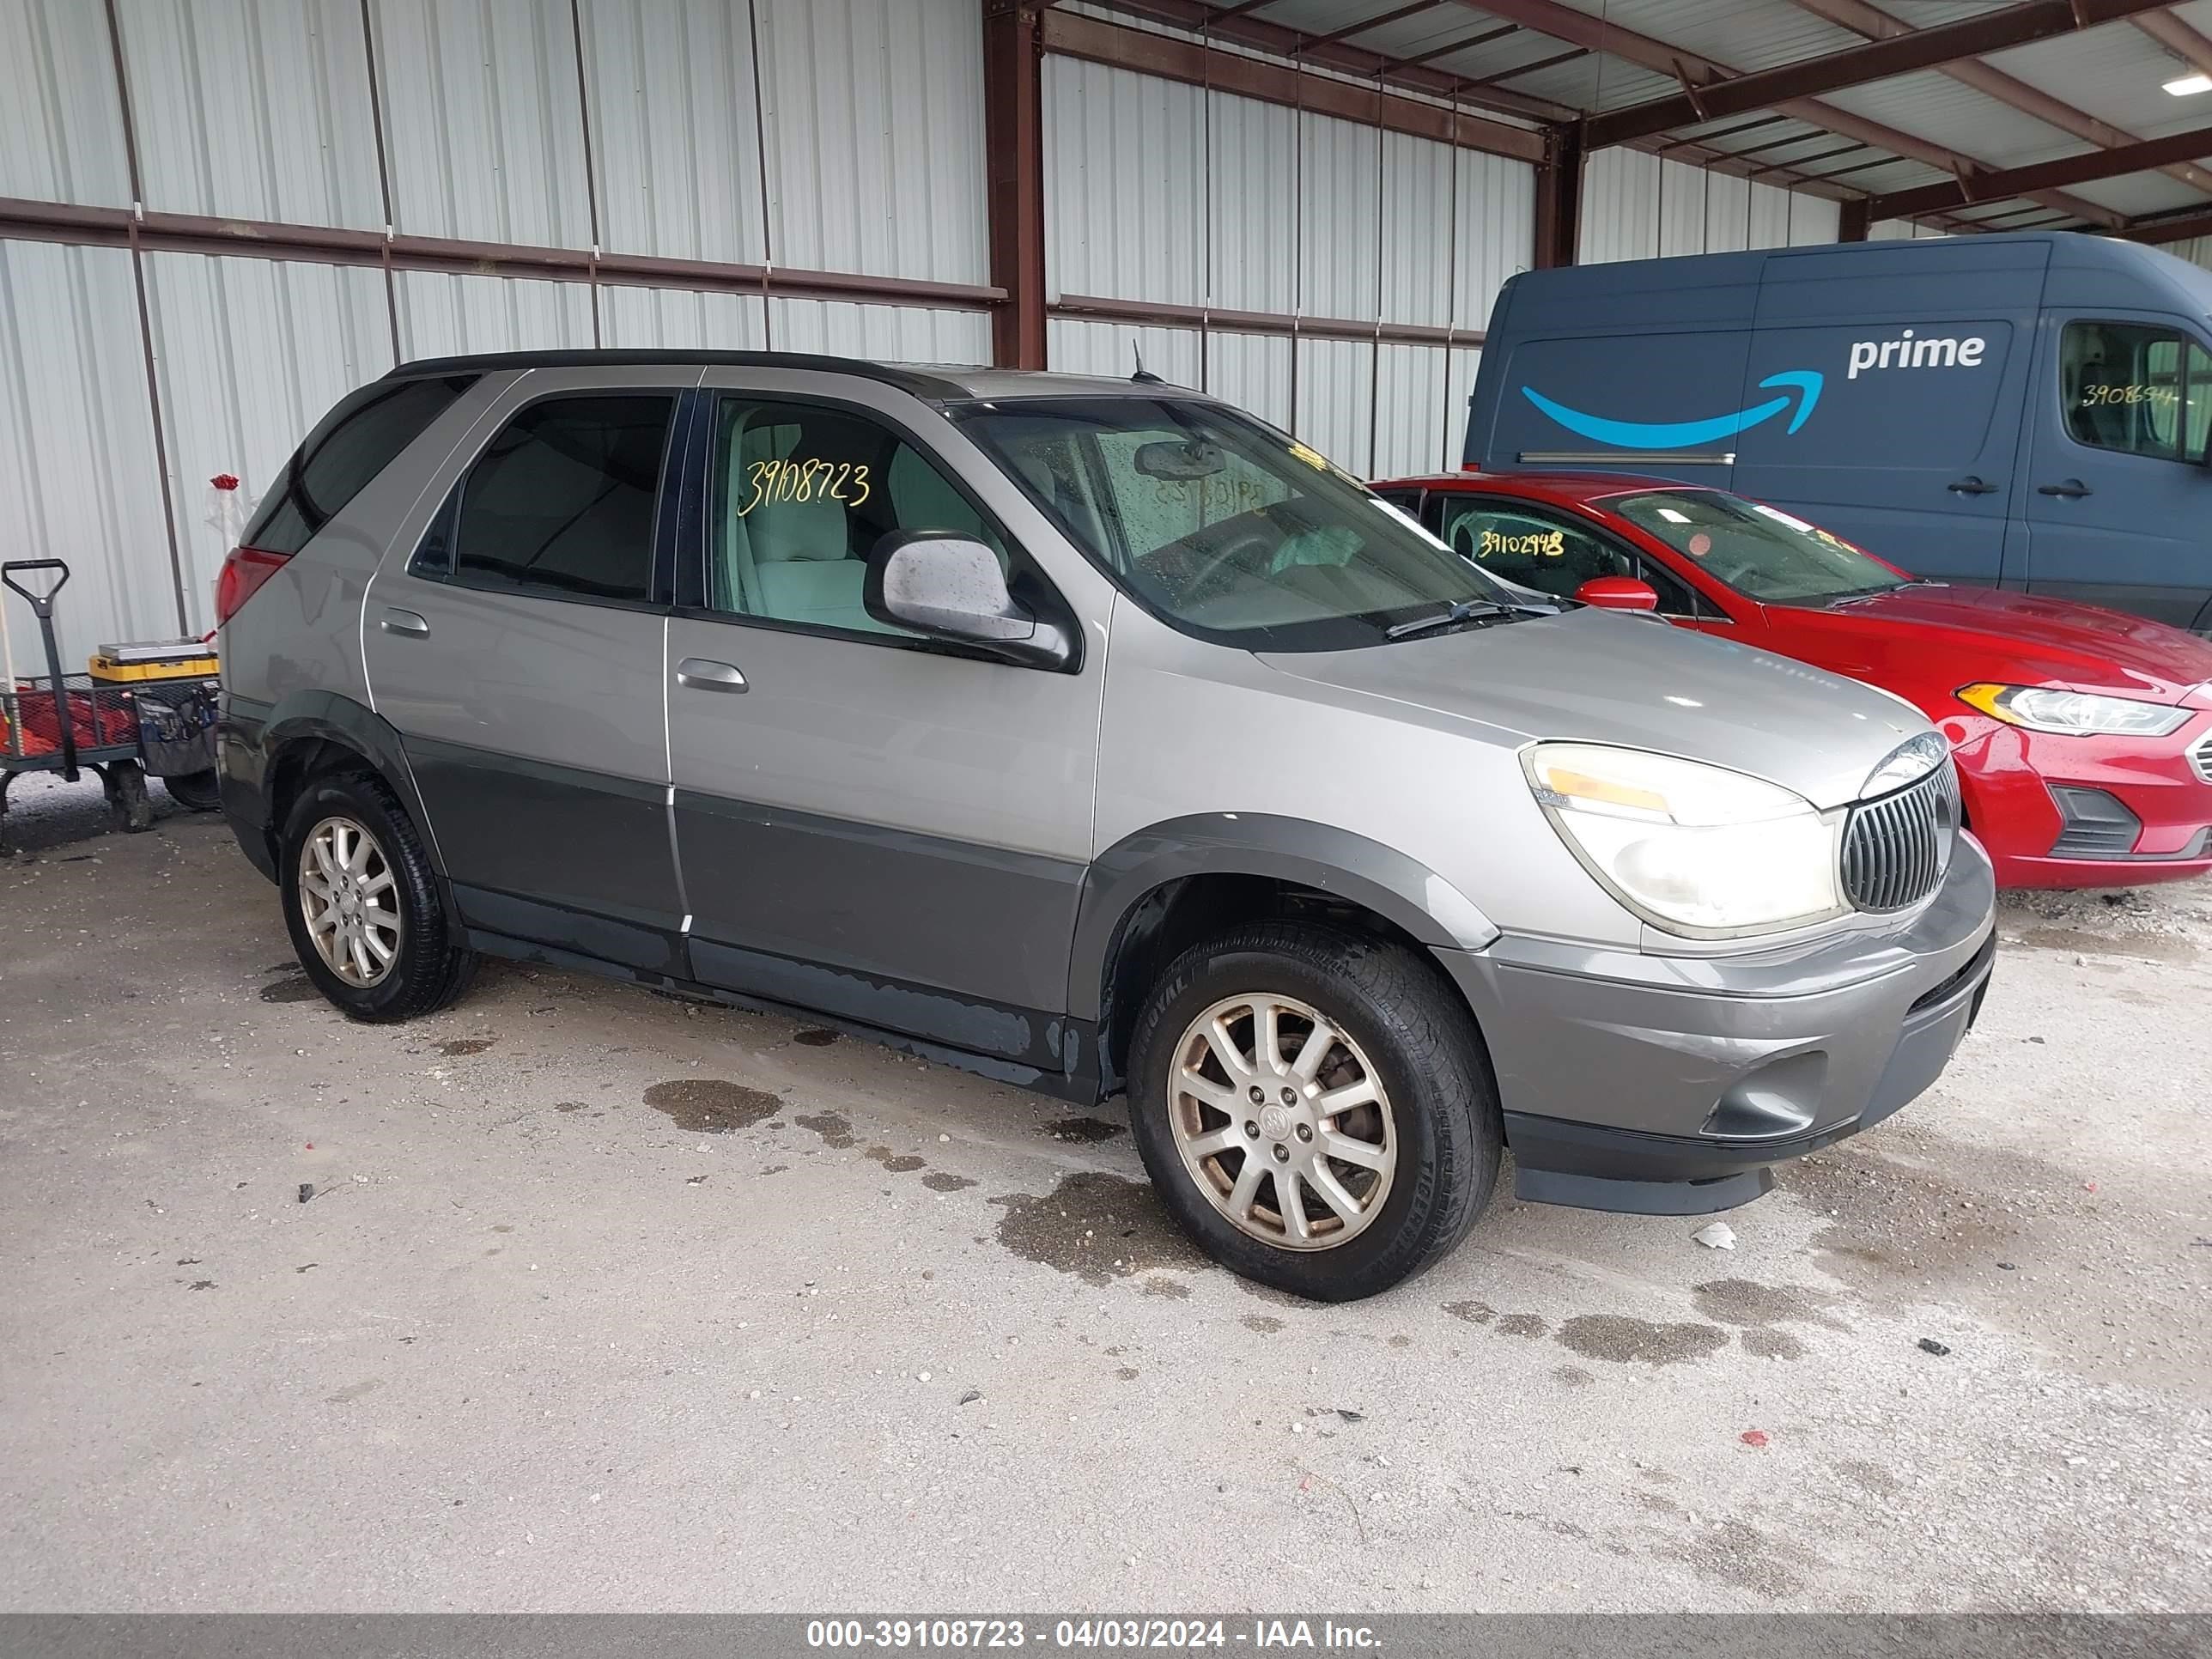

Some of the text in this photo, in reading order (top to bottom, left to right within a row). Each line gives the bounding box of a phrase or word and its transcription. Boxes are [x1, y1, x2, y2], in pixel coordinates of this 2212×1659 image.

[1847, 329, 1985, 380] prime
[737, 458, 871, 517] 39108723
[1478, 531, 1565, 558] 39102948
